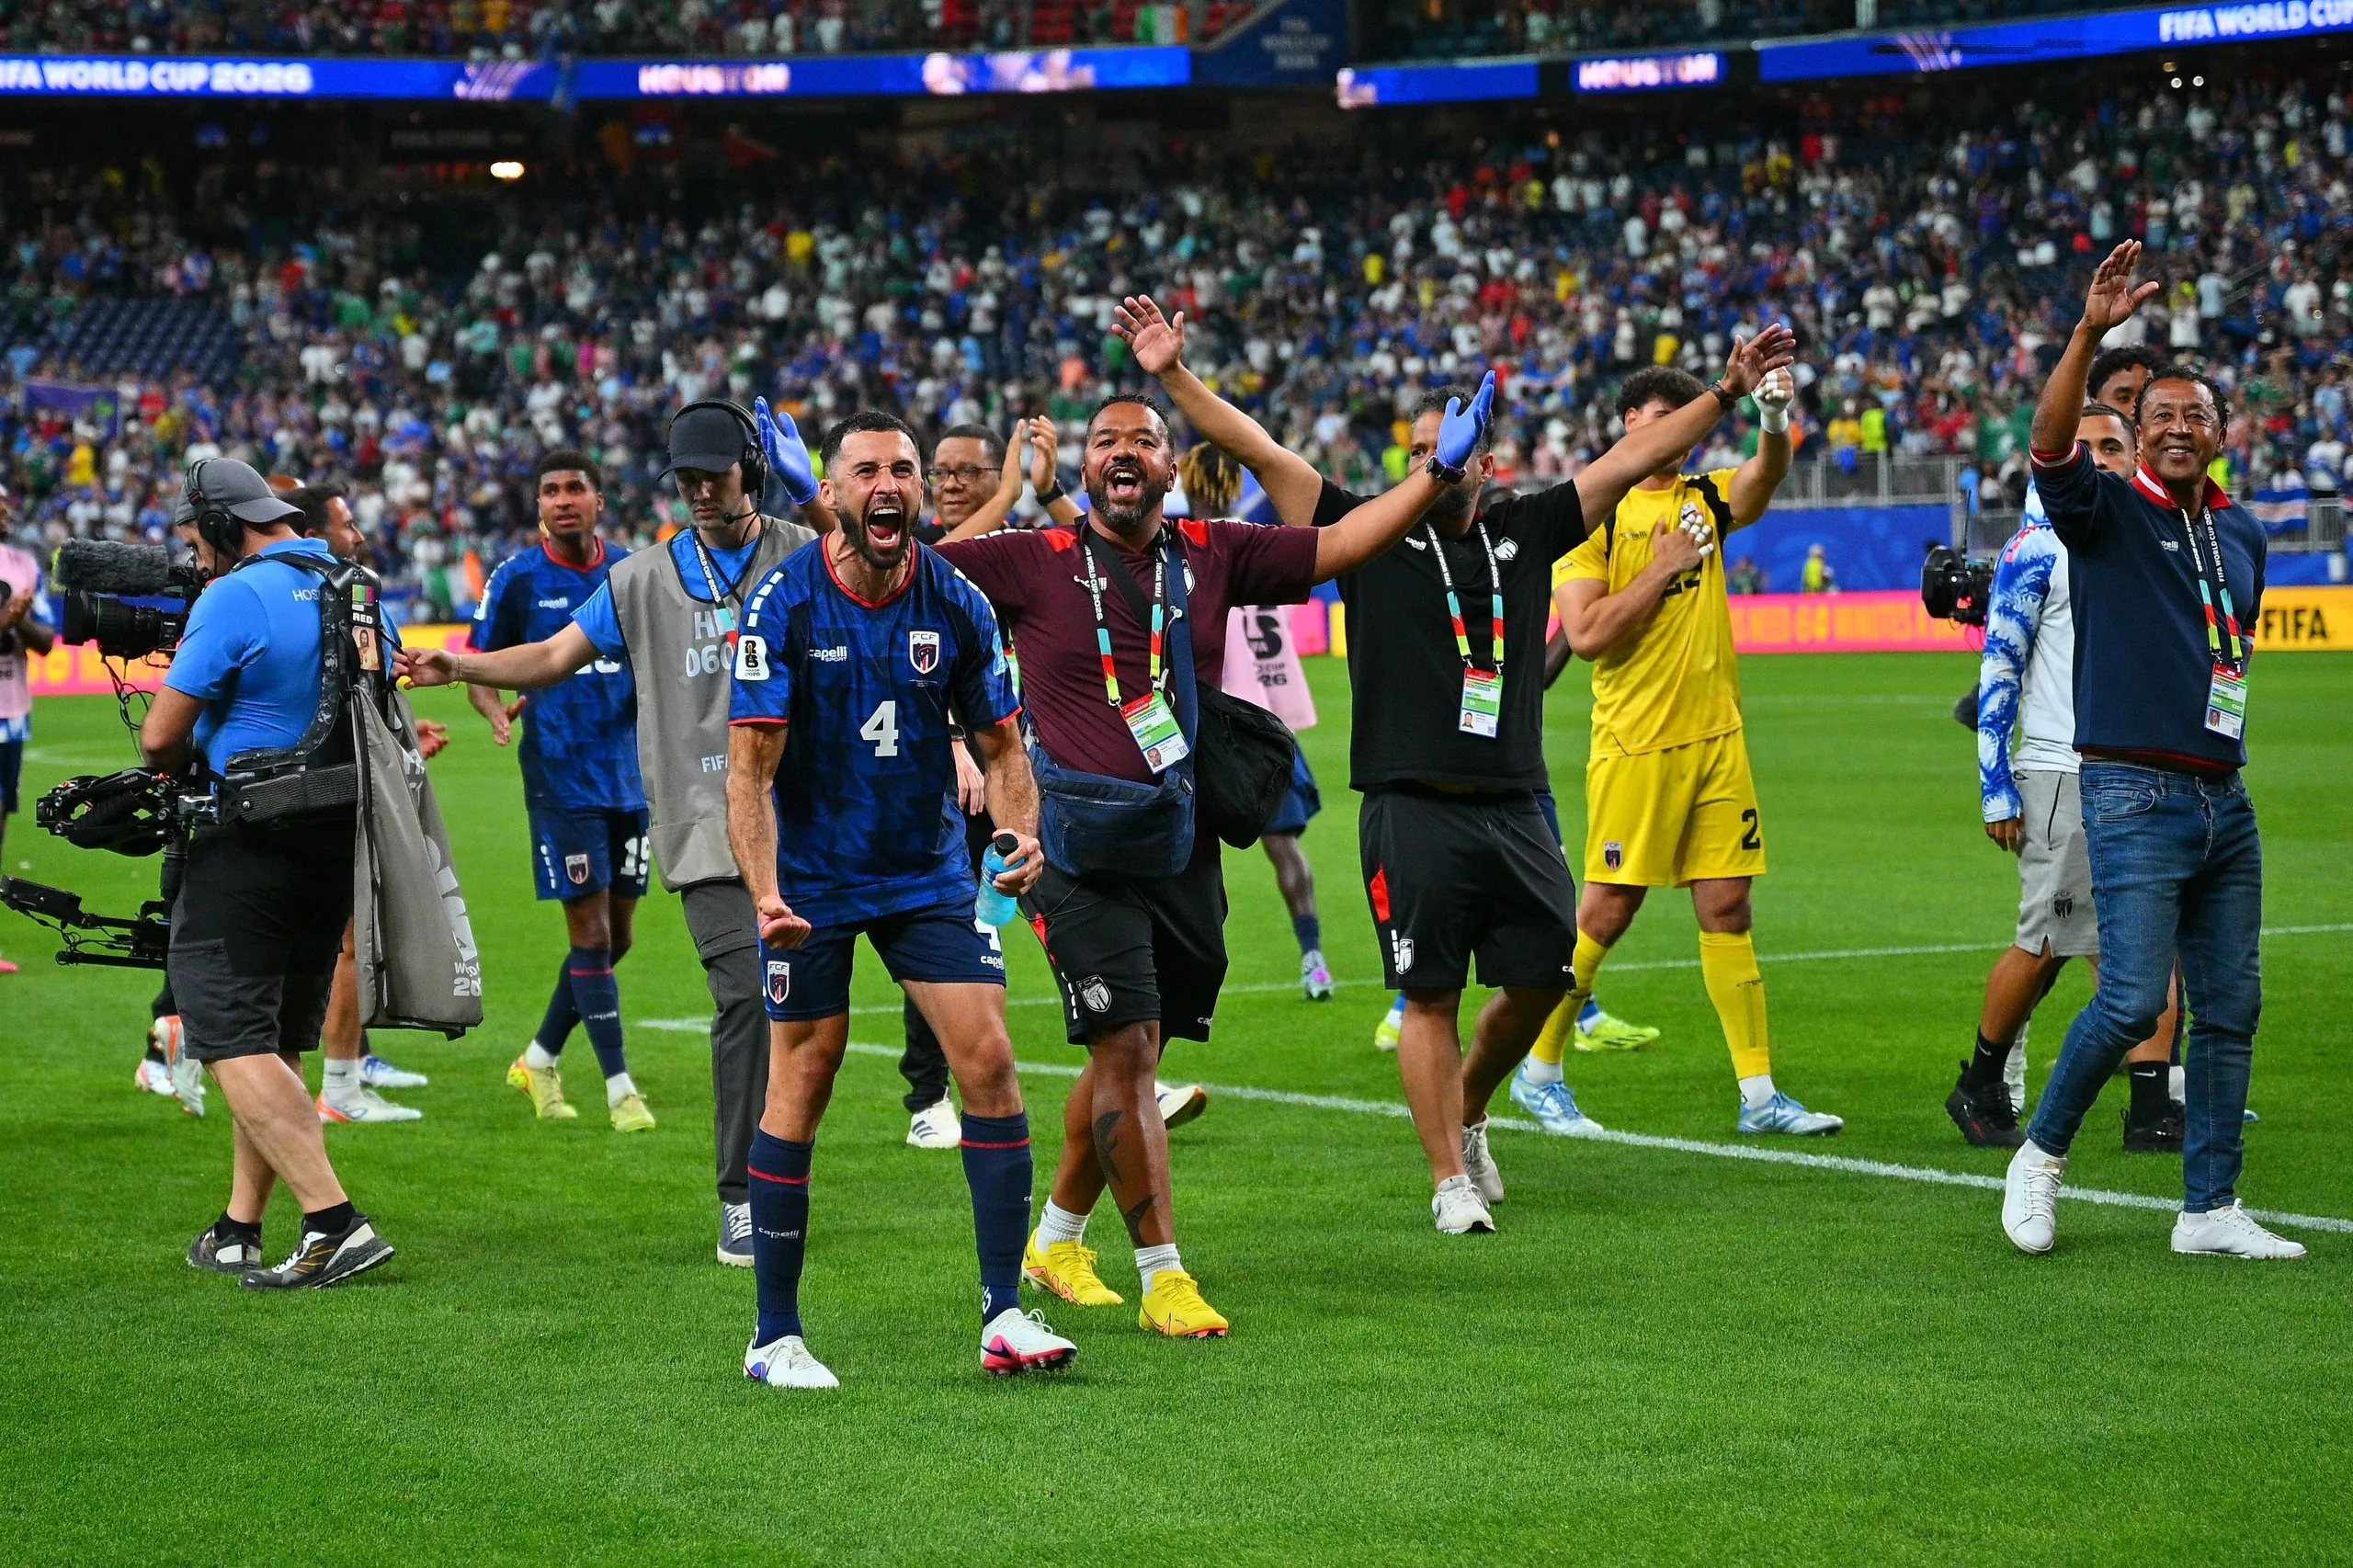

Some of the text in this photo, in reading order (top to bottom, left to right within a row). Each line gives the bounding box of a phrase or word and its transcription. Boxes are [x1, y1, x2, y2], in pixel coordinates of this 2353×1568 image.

[2160, 9, 2215, 42] FIFA
[2214, 0, 2307, 36] WORLD
[42, 60, 150, 91] WORLD
[150, 61, 210, 91] CUP
[210, 62, 314, 93] 2026
[1086, 556, 1097, 579] WORLD
[2217, 566, 2225, 583] FIFA
[708, 578, 722, 603] 2026
[1090, 578, 1099, 594] CUP
[539, 597, 569, 609] capelli
[1092, 593, 1104, 621] 2026
[352, 612, 373, 625] RED
[2264, 608, 2327, 640] FIFA
[912, 632, 938, 641] FCF
[859, 700, 899, 757] 4
[701, 754, 728, 772] FIF
[1741, 808, 1761, 850] 2
[758, 1227, 800, 1238] capelli
